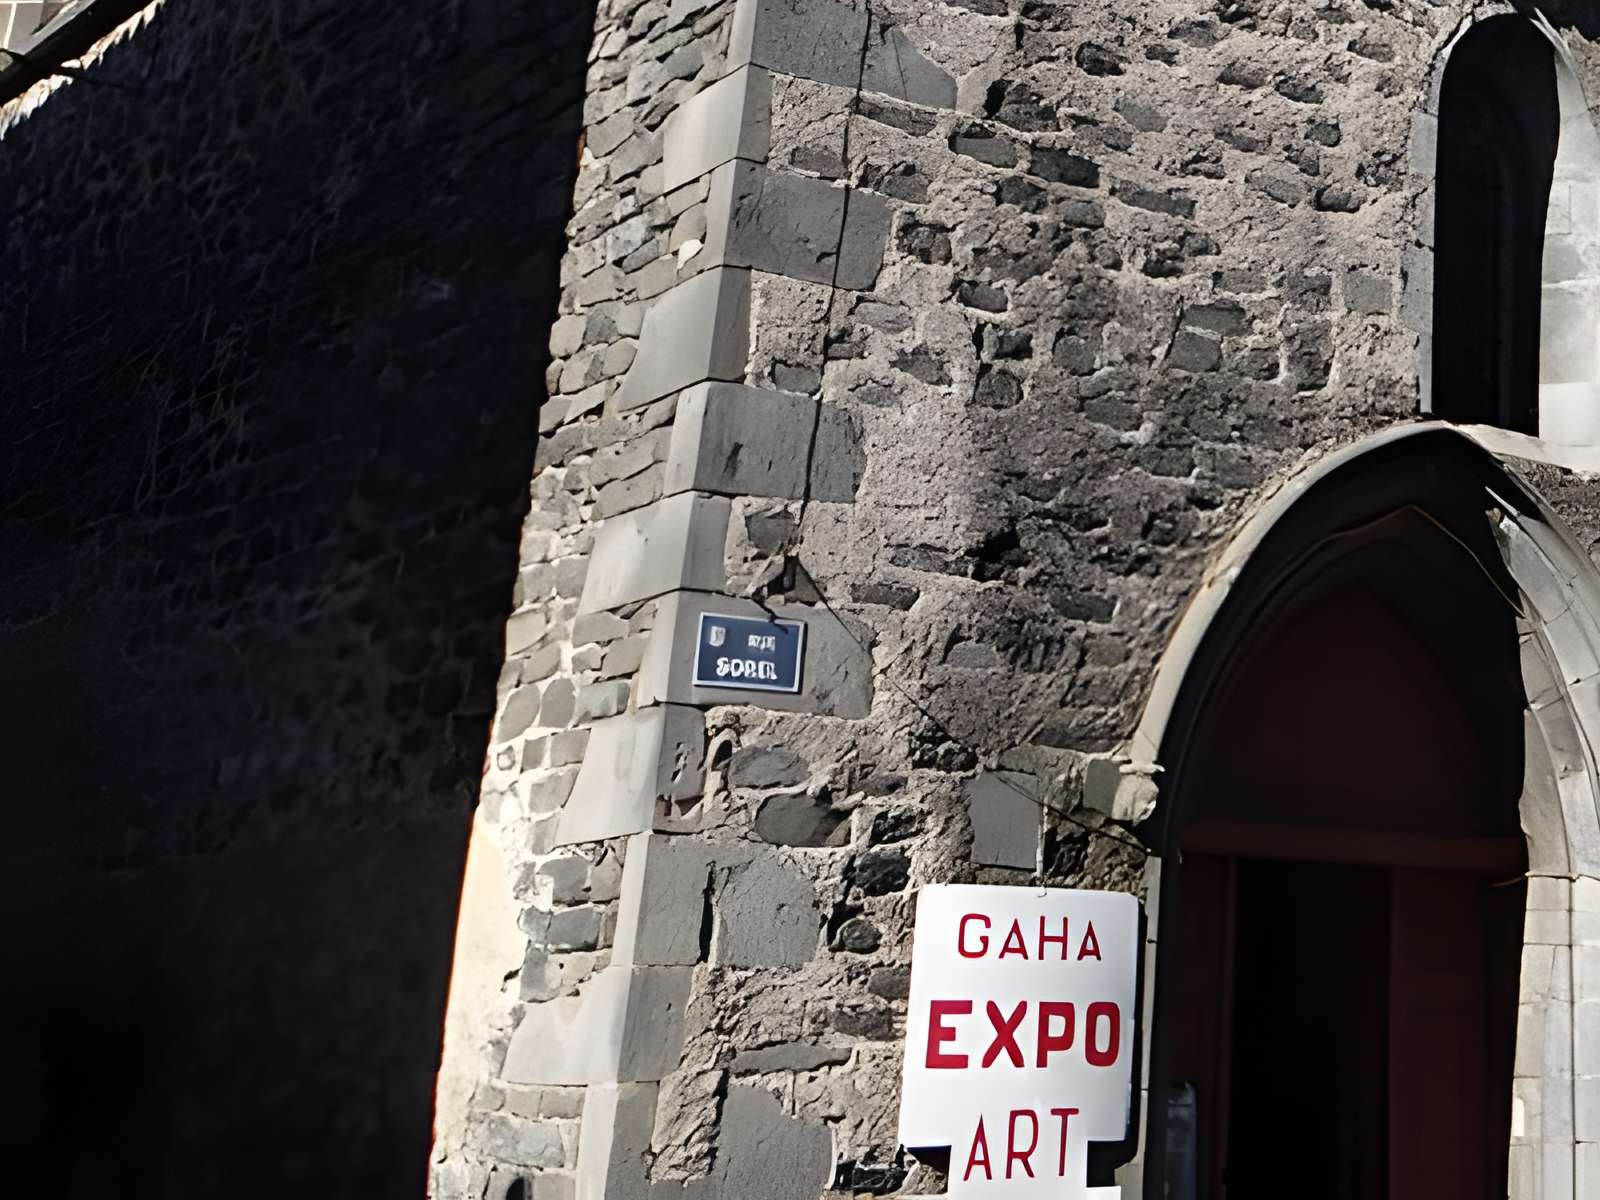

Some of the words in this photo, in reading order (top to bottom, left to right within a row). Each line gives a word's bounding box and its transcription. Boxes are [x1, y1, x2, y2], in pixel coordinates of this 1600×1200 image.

[958, 913, 1102, 961] GAHA
[925, 999, 1121, 1069] EXPO
[963, 1107, 1080, 1182] ART
